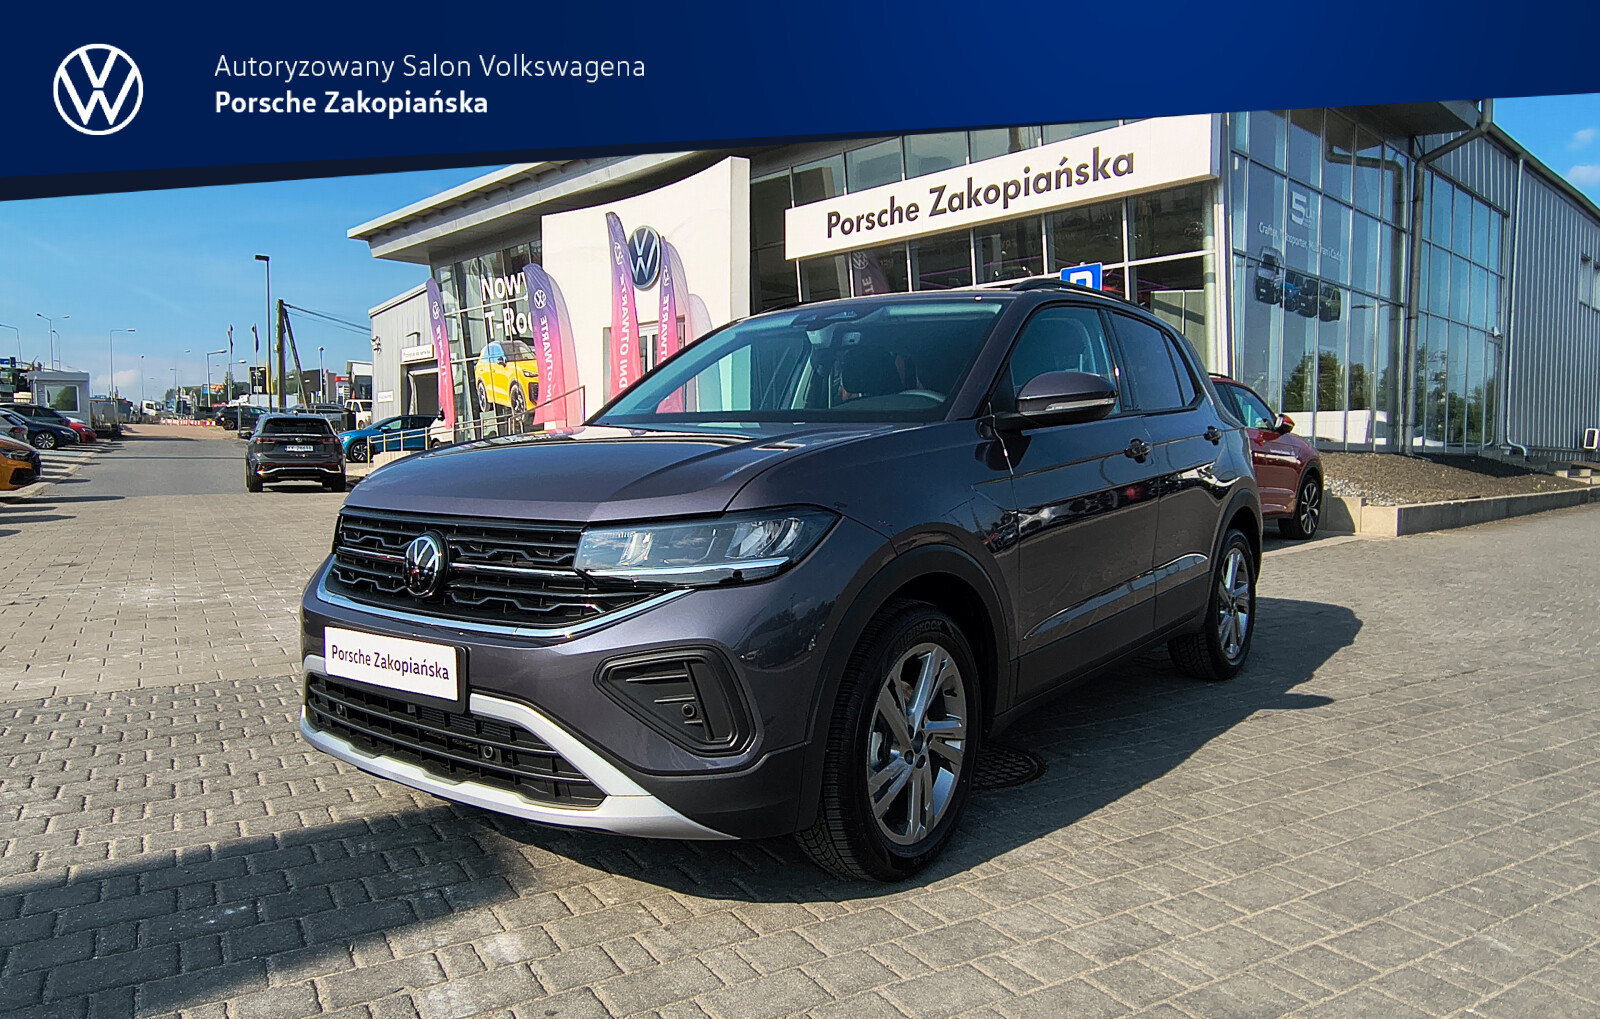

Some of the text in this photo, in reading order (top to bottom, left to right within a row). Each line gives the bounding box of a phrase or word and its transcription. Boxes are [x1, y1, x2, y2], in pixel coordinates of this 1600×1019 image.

[826, 146, 1135, 239] Porsche Zakopiańska
[331, 644, 450, 682] Porsche Zakopiańska
